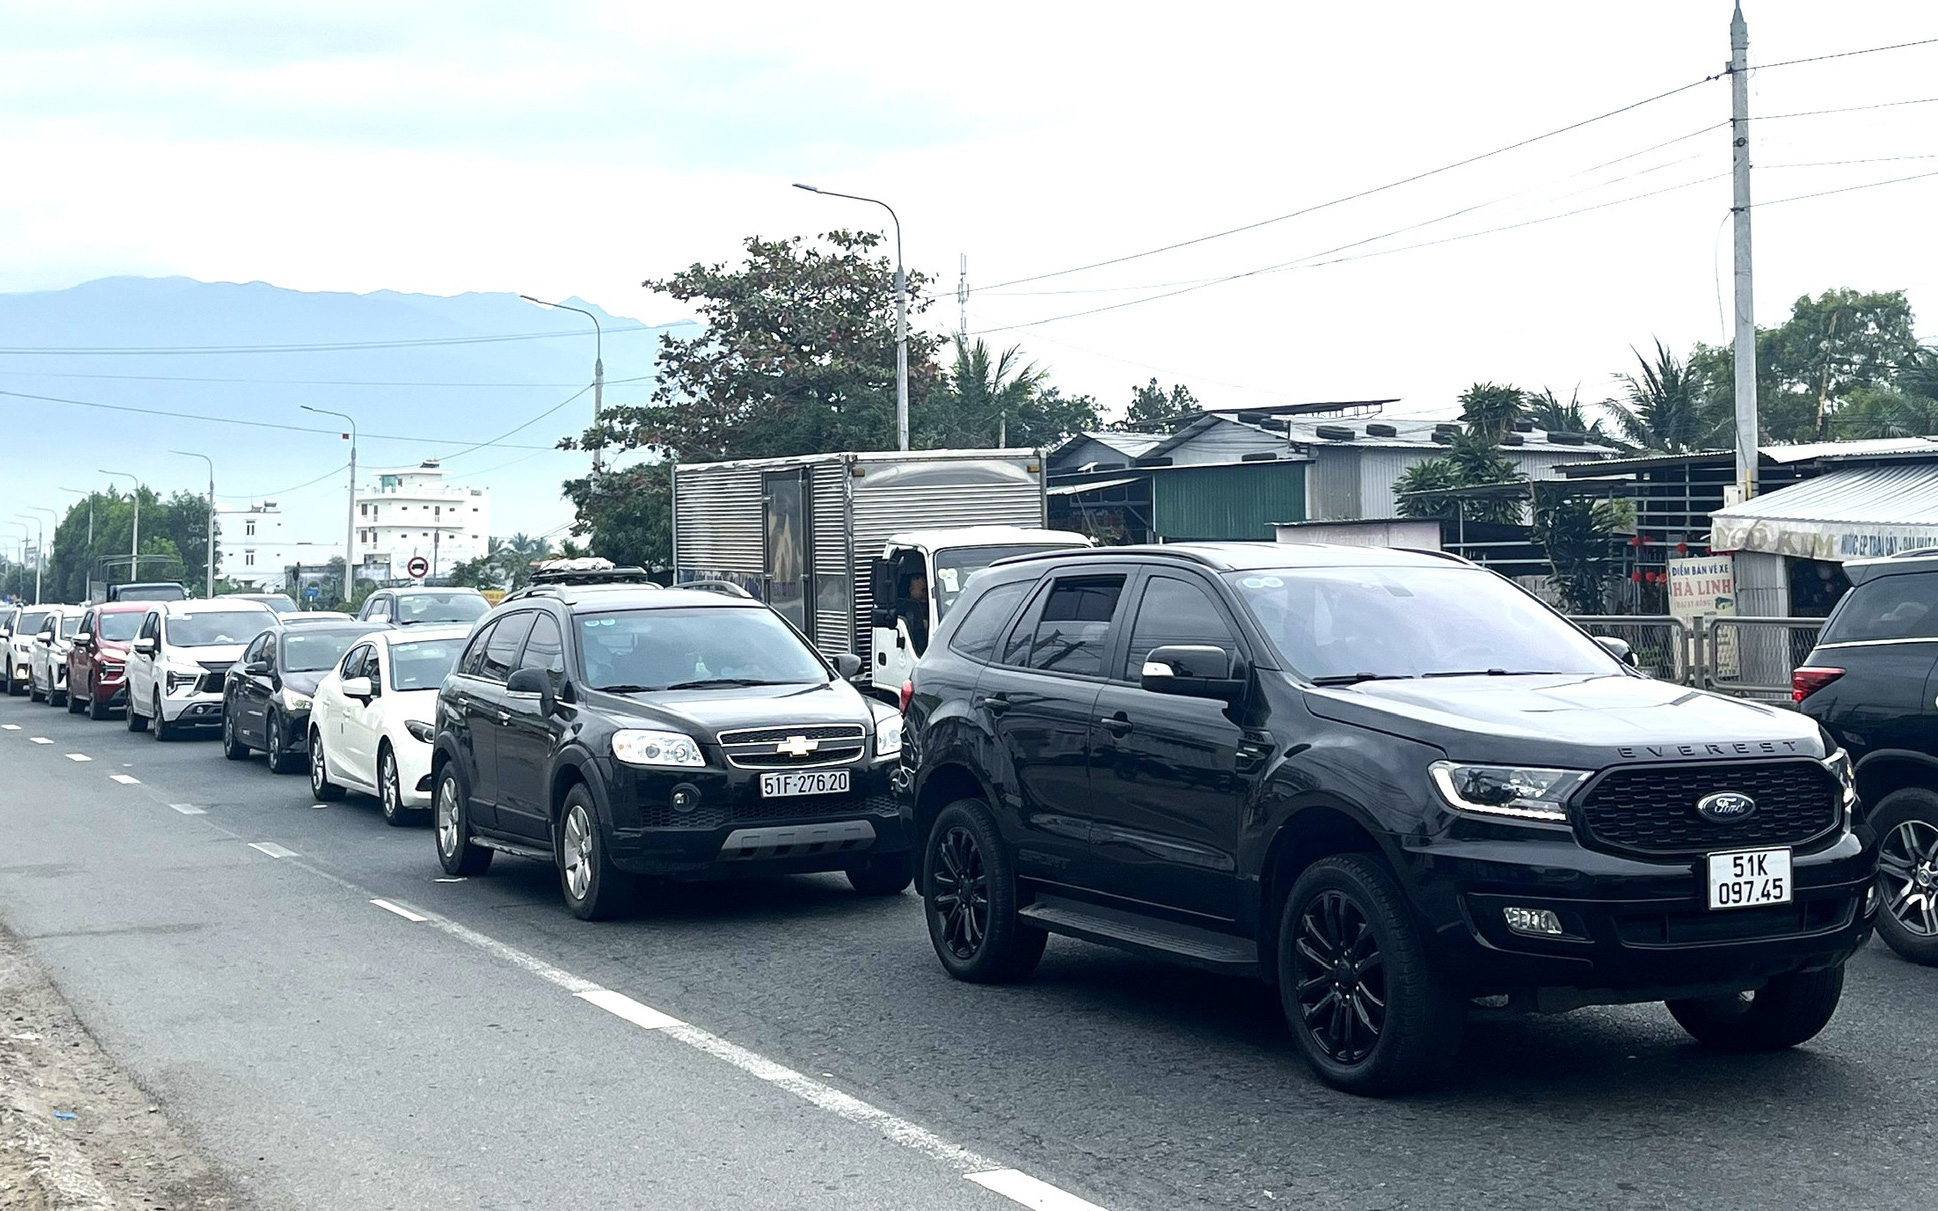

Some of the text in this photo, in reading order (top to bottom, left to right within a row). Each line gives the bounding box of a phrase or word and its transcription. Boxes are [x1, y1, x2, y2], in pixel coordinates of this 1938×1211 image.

[1776, 531, 1835, 559] KIM
[1672, 562, 1690, 576] ĐIỂM
[1719, 563, 1729, 574] XE
[1672, 578, 1732, 597] HÀ LINH
[1617, 741, 1797, 758] EVEREST
[1713, 797, 1745, 815] Ford
[1733, 853, 1768, 878] 51K
[1718, 878, 1783, 905] 097.45
